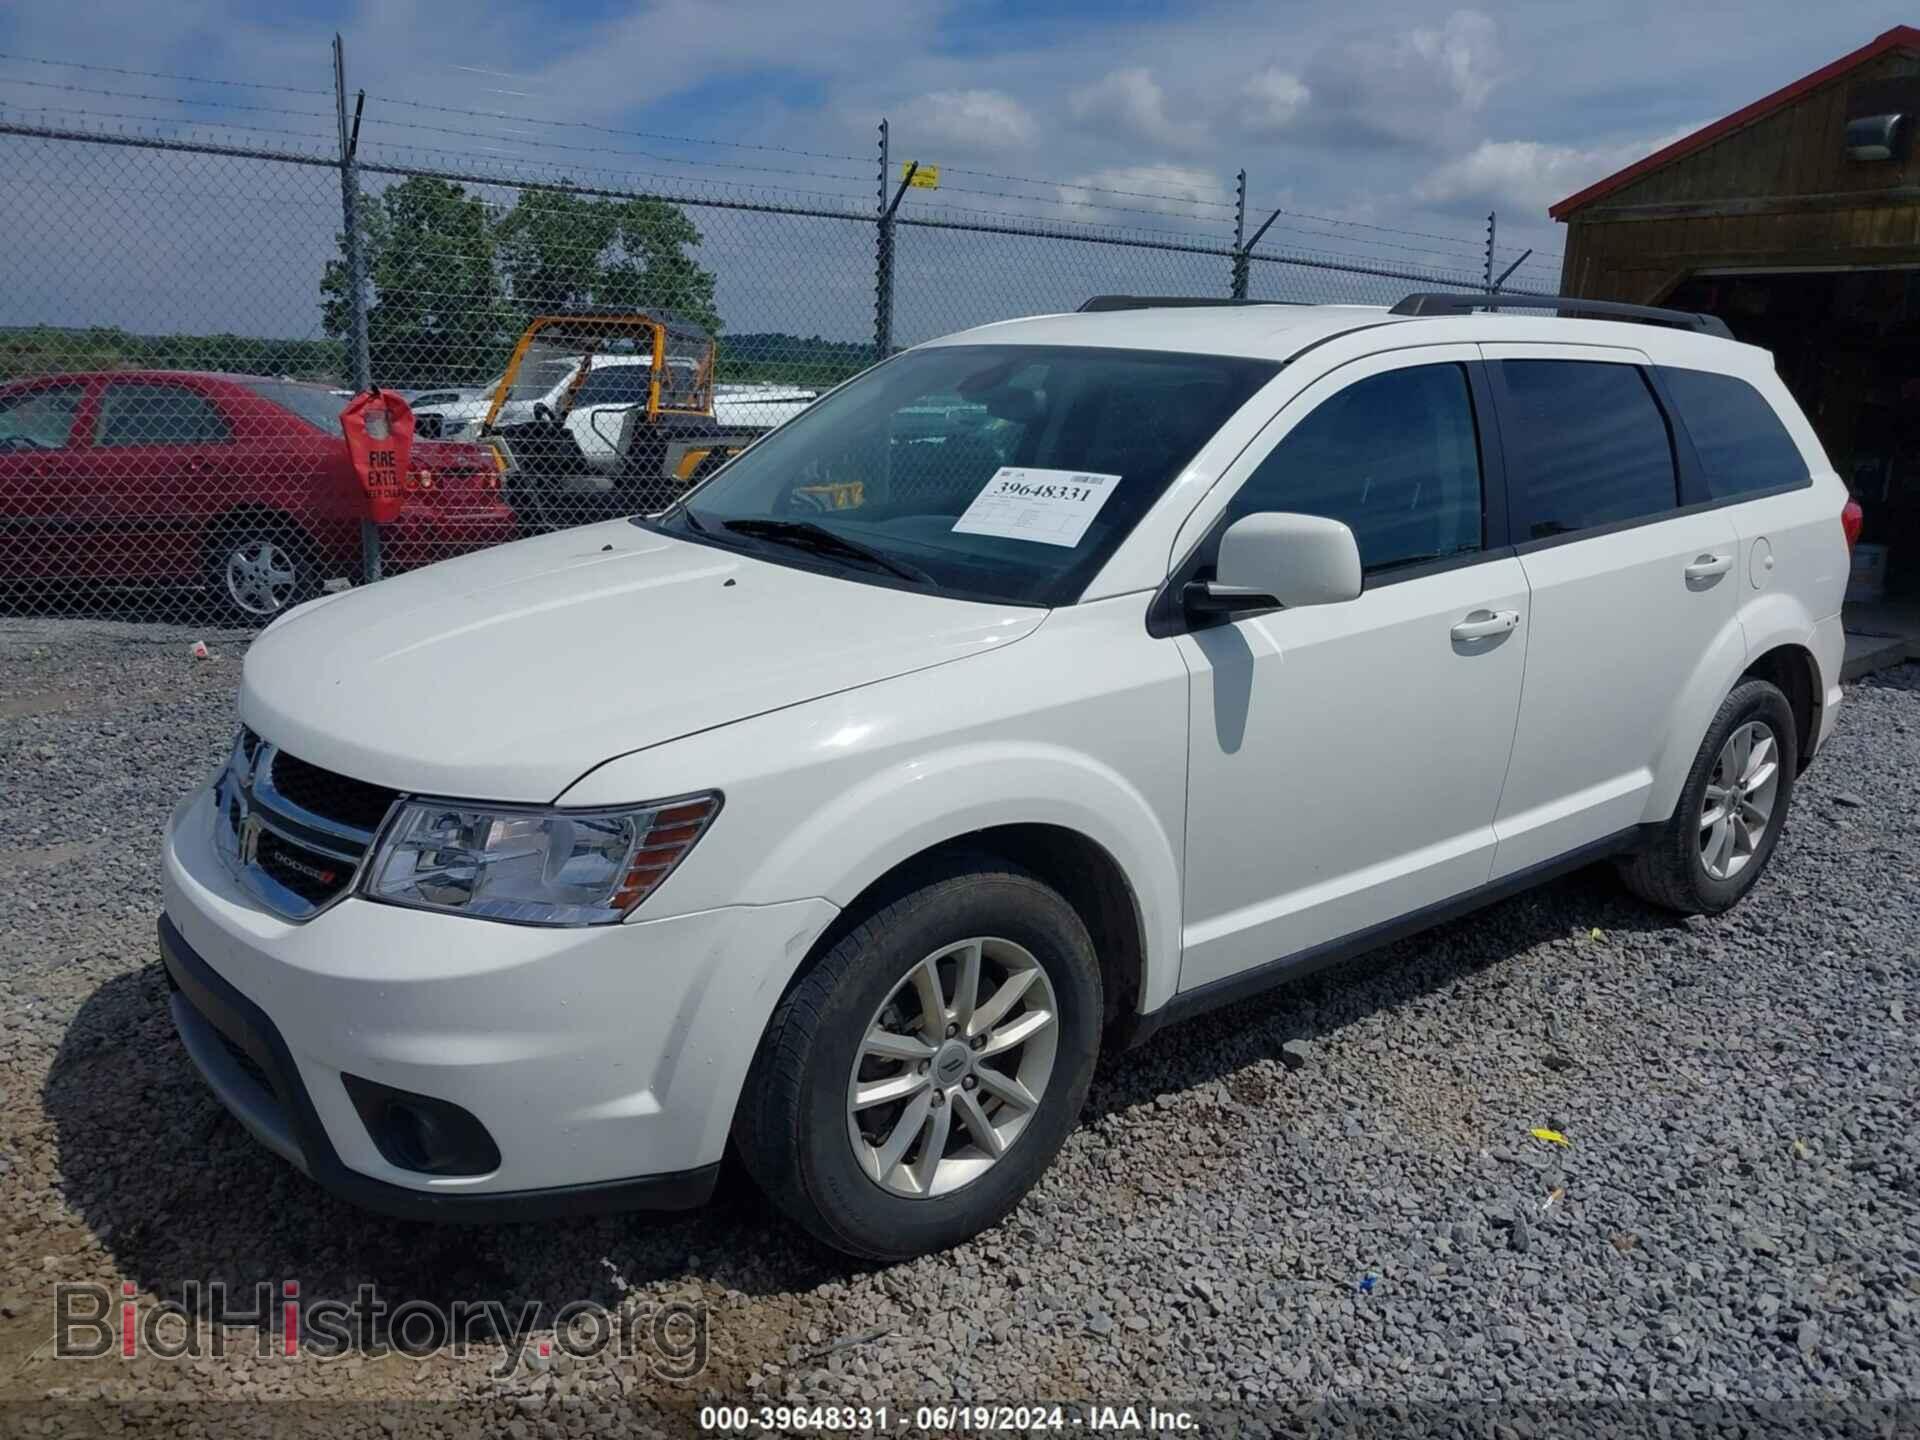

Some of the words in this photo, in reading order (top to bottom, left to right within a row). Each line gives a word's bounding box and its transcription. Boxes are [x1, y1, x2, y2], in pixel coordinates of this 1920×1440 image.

[369, 450, 396, 468] FIRE
[994, 481, 1092, 502] 39648331
[274, 851, 321, 880] DODGE
